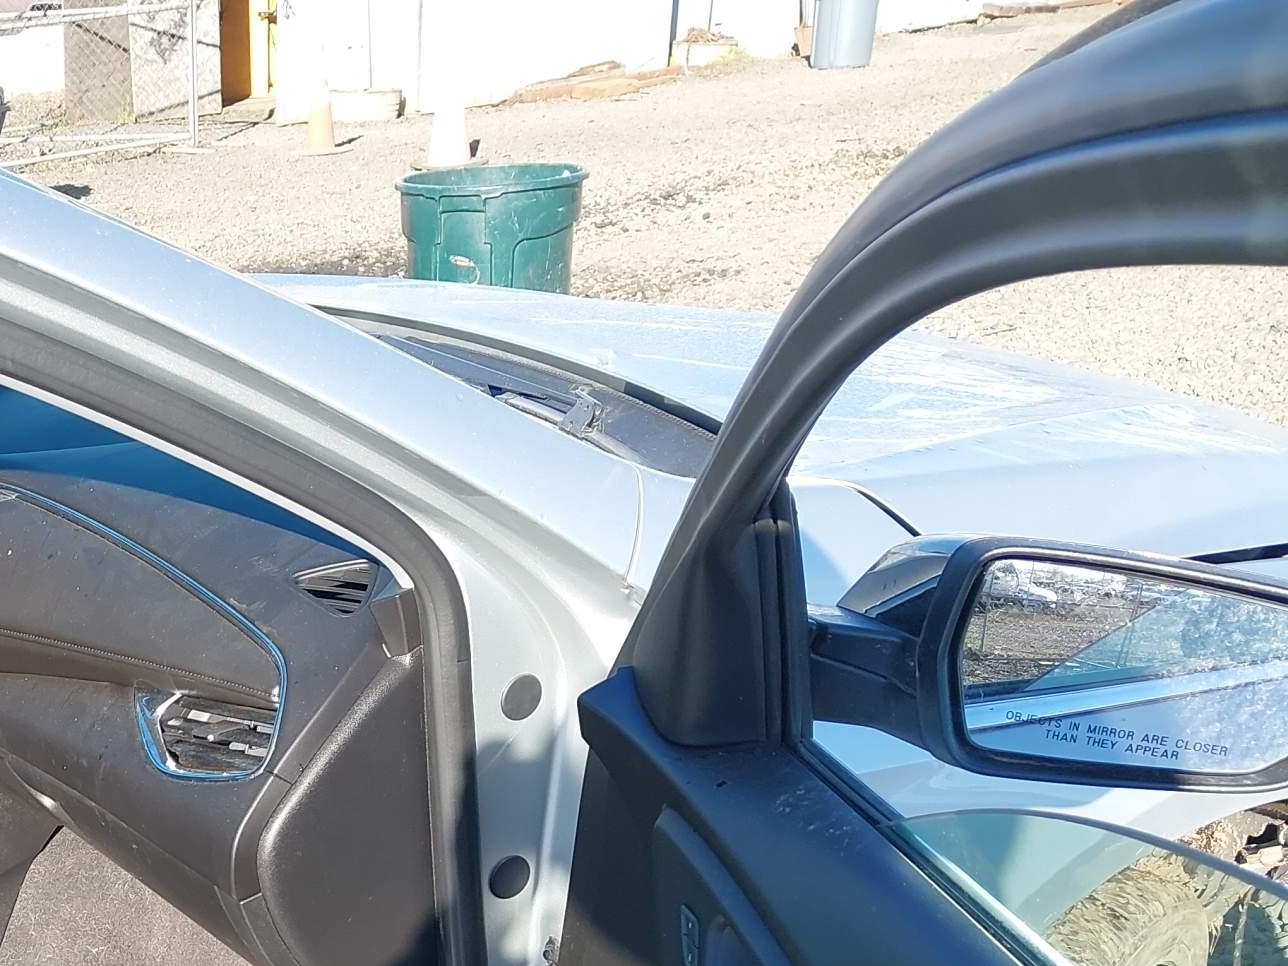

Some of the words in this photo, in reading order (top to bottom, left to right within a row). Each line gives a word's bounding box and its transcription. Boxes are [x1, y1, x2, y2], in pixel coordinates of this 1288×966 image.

[1006, 710, 1062, 728] OBJECTS
[1068, 720, 1081, 732] IN
[1086, 724, 1135, 740] MIRROR
[1140, 733, 1169, 747] ARE
[1175, 739, 1229, 757] CLOSER
[1045, 729, 1078, 743] THAN
[1086, 736, 1118, 750] THEY
[1124, 743, 1179, 760] APPEAR
